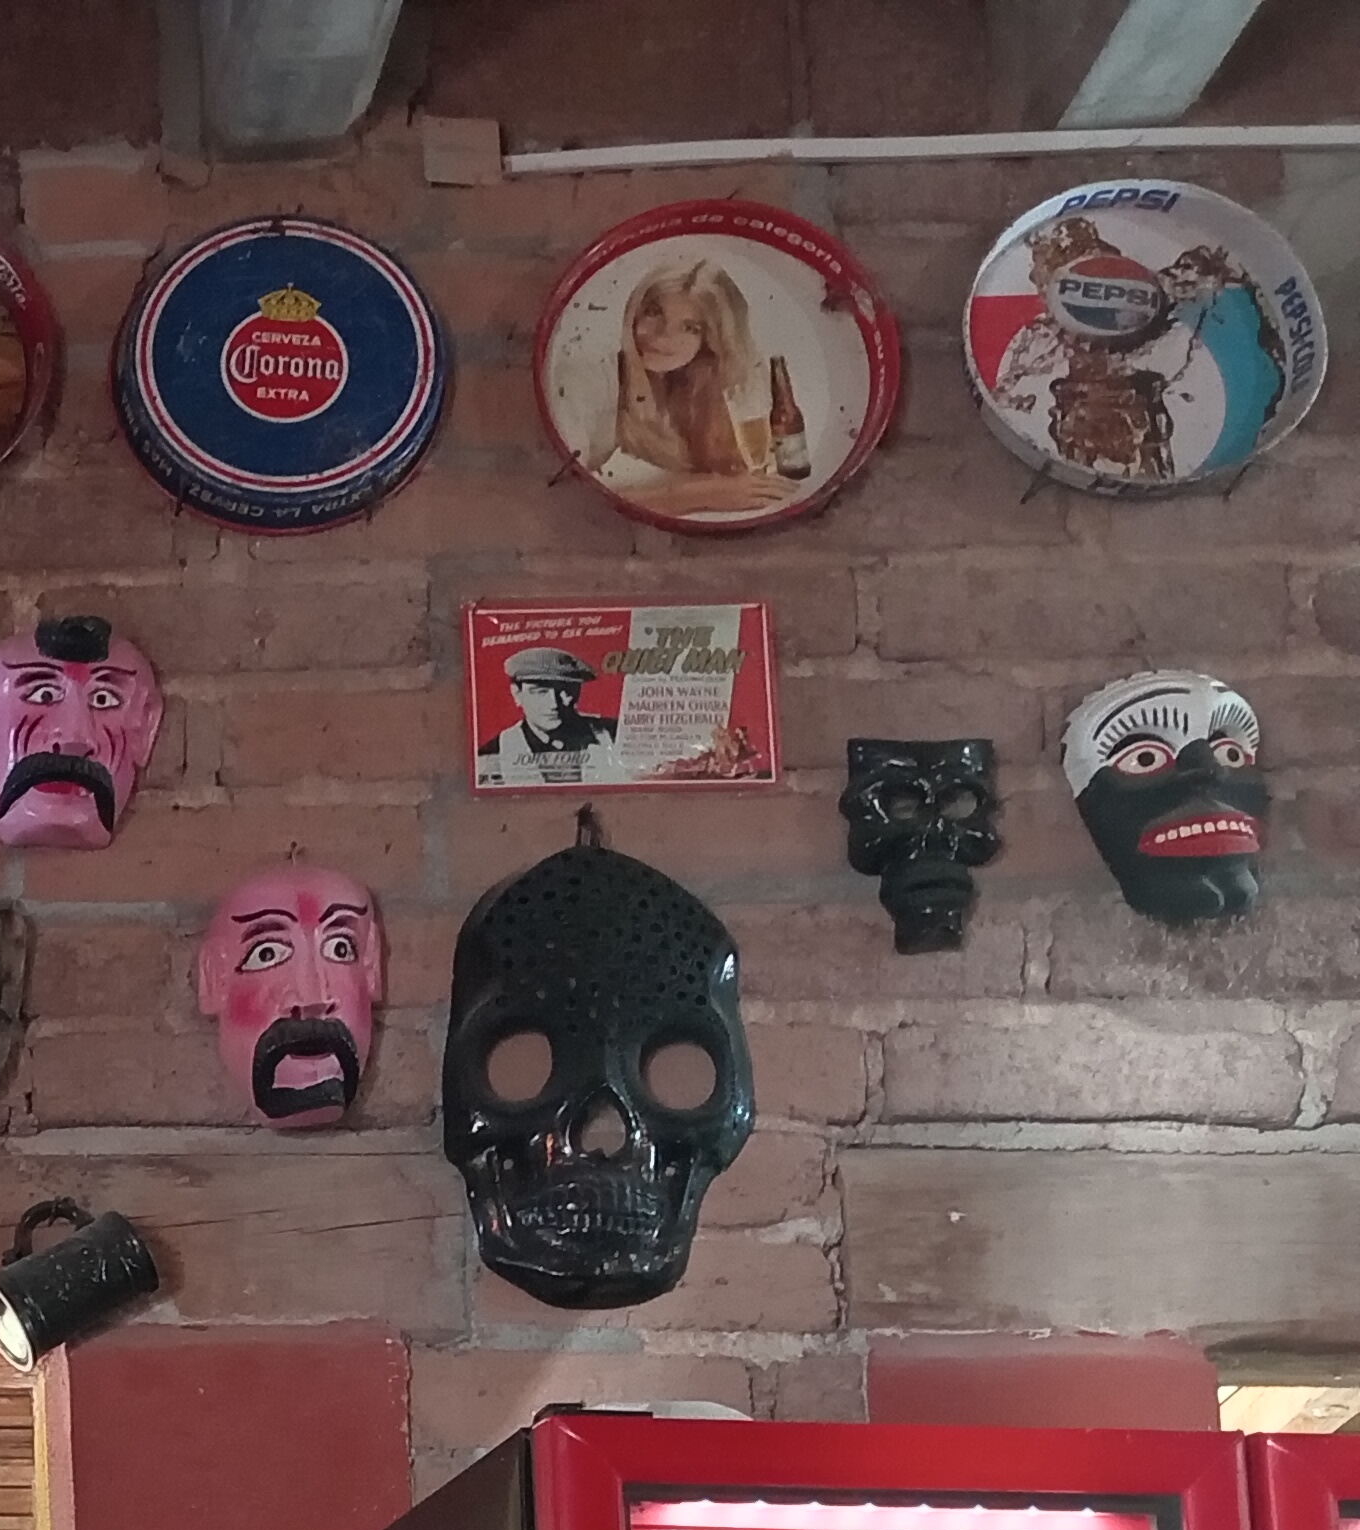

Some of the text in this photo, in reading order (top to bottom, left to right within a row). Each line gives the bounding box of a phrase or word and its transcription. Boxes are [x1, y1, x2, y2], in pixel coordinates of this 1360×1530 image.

[1055, 187, 1181, 218] PEPSI
[1059, 279, 1159, 306] PEPSI
[251, 331, 321, 346] CERVEZA
[229, 343, 340, 384] Corona
[256, 386, 310, 402] EXTRA
[654, 626, 715, 650] THE
[601, 648, 747, 676] QUIET MAN
[639, 686, 721, 698] JOHN WAYNE
